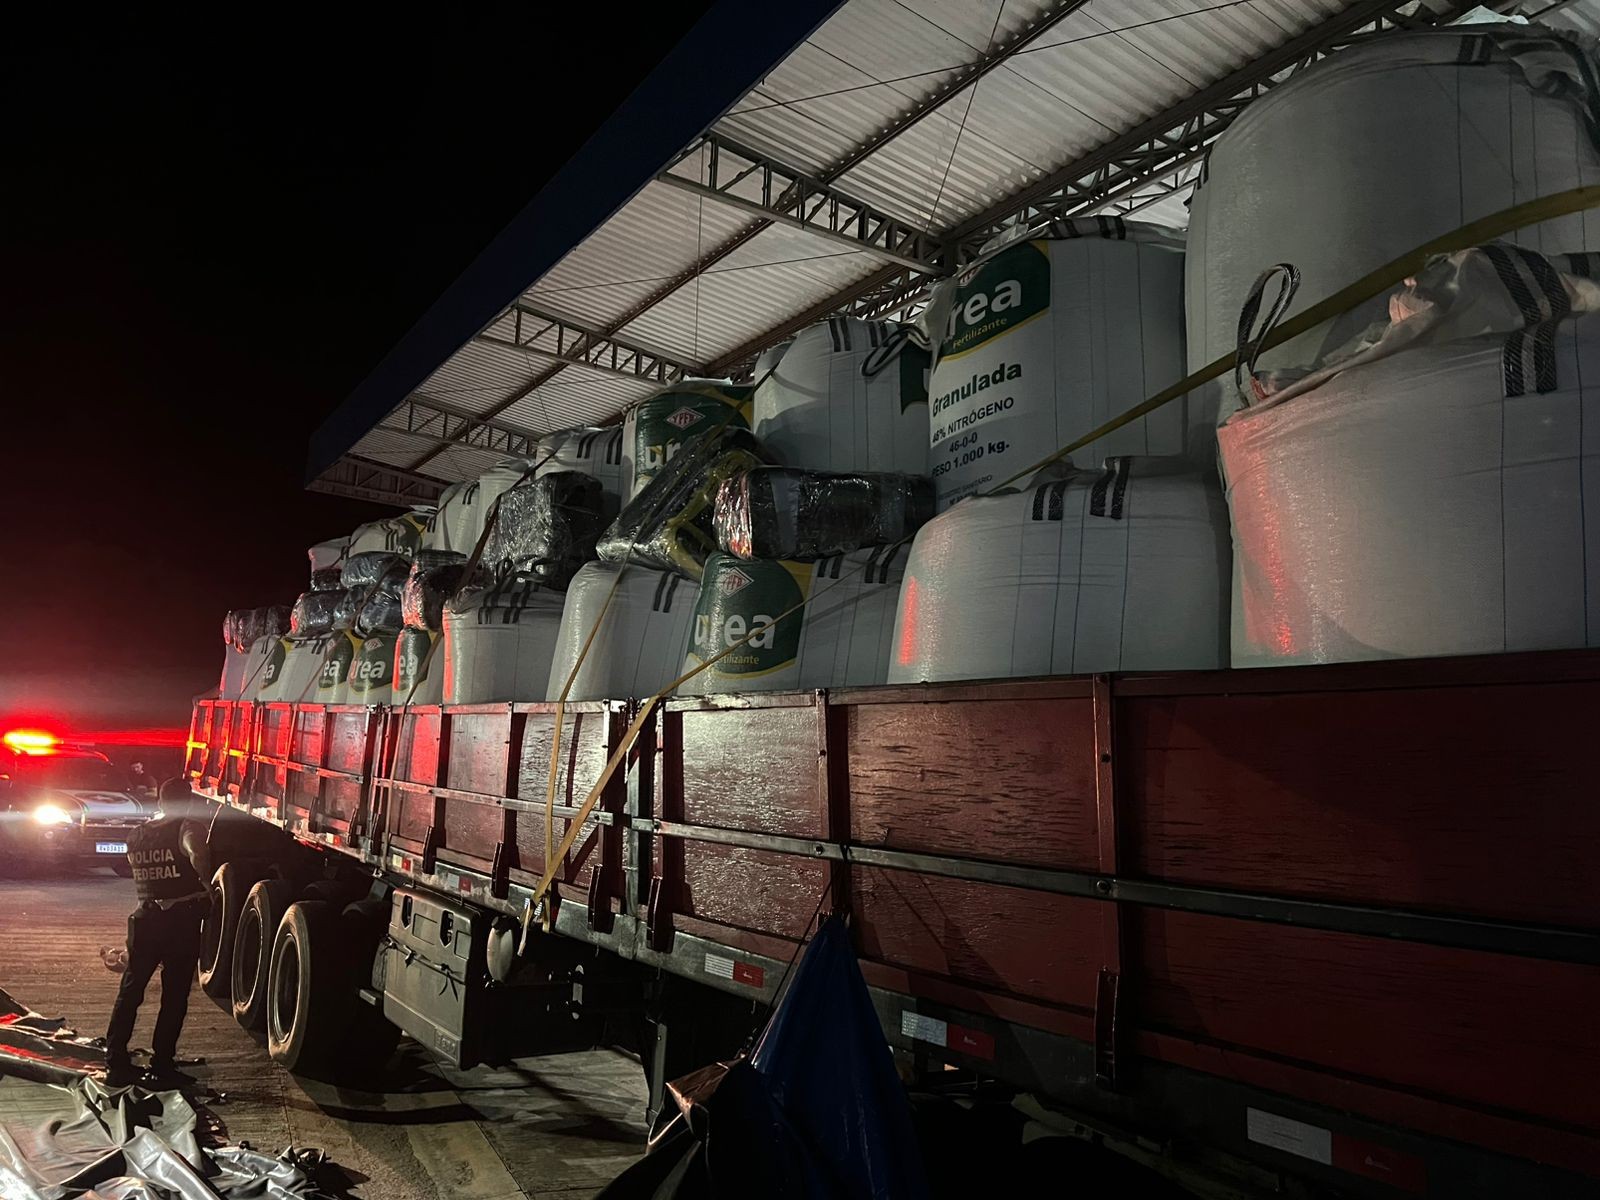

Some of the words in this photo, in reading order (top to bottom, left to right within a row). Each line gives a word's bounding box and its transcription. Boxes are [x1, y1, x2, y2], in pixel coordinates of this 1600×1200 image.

[948, 279, 1022, 337] rea
[932, 362, 1022, 418] Granulada
[947, 397, 1015, 436] NITRÓGENO
[646, 442, 681, 470] ur
[949, 431, 978, 453] 46-0-0
[931, 461, 951, 479] PESO
[953, 446, 984, 469] 1.000
[988, 441, 1010, 454] kg.
[324, 660, 341, 677] ea
[132, 865, 181, 881] FEDERAL
